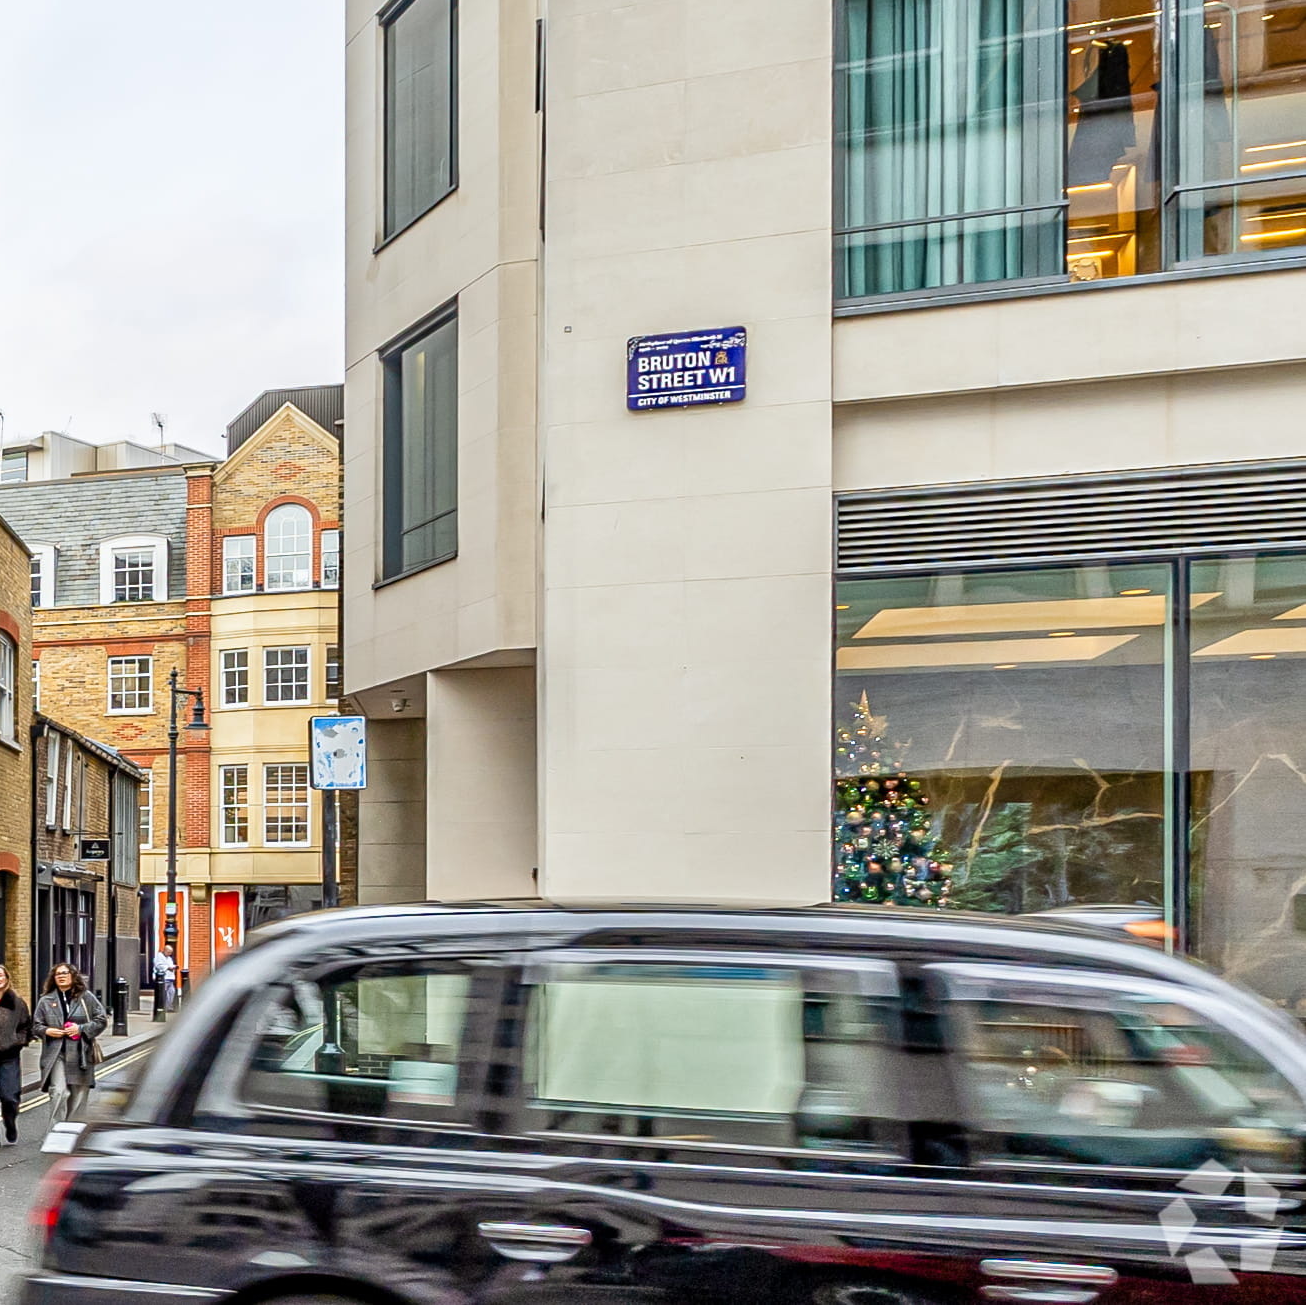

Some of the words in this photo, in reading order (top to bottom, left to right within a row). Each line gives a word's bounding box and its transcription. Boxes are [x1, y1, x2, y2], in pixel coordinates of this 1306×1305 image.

[637, 351, 711, 373] BRUTON
[637, 370, 706, 390] STREET
[708, 366, 735, 384] W1
[637, 397, 658, 406] CITY
[658, 396, 670, 405] OF
[670, 391, 731, 403] WESTMINSTER
